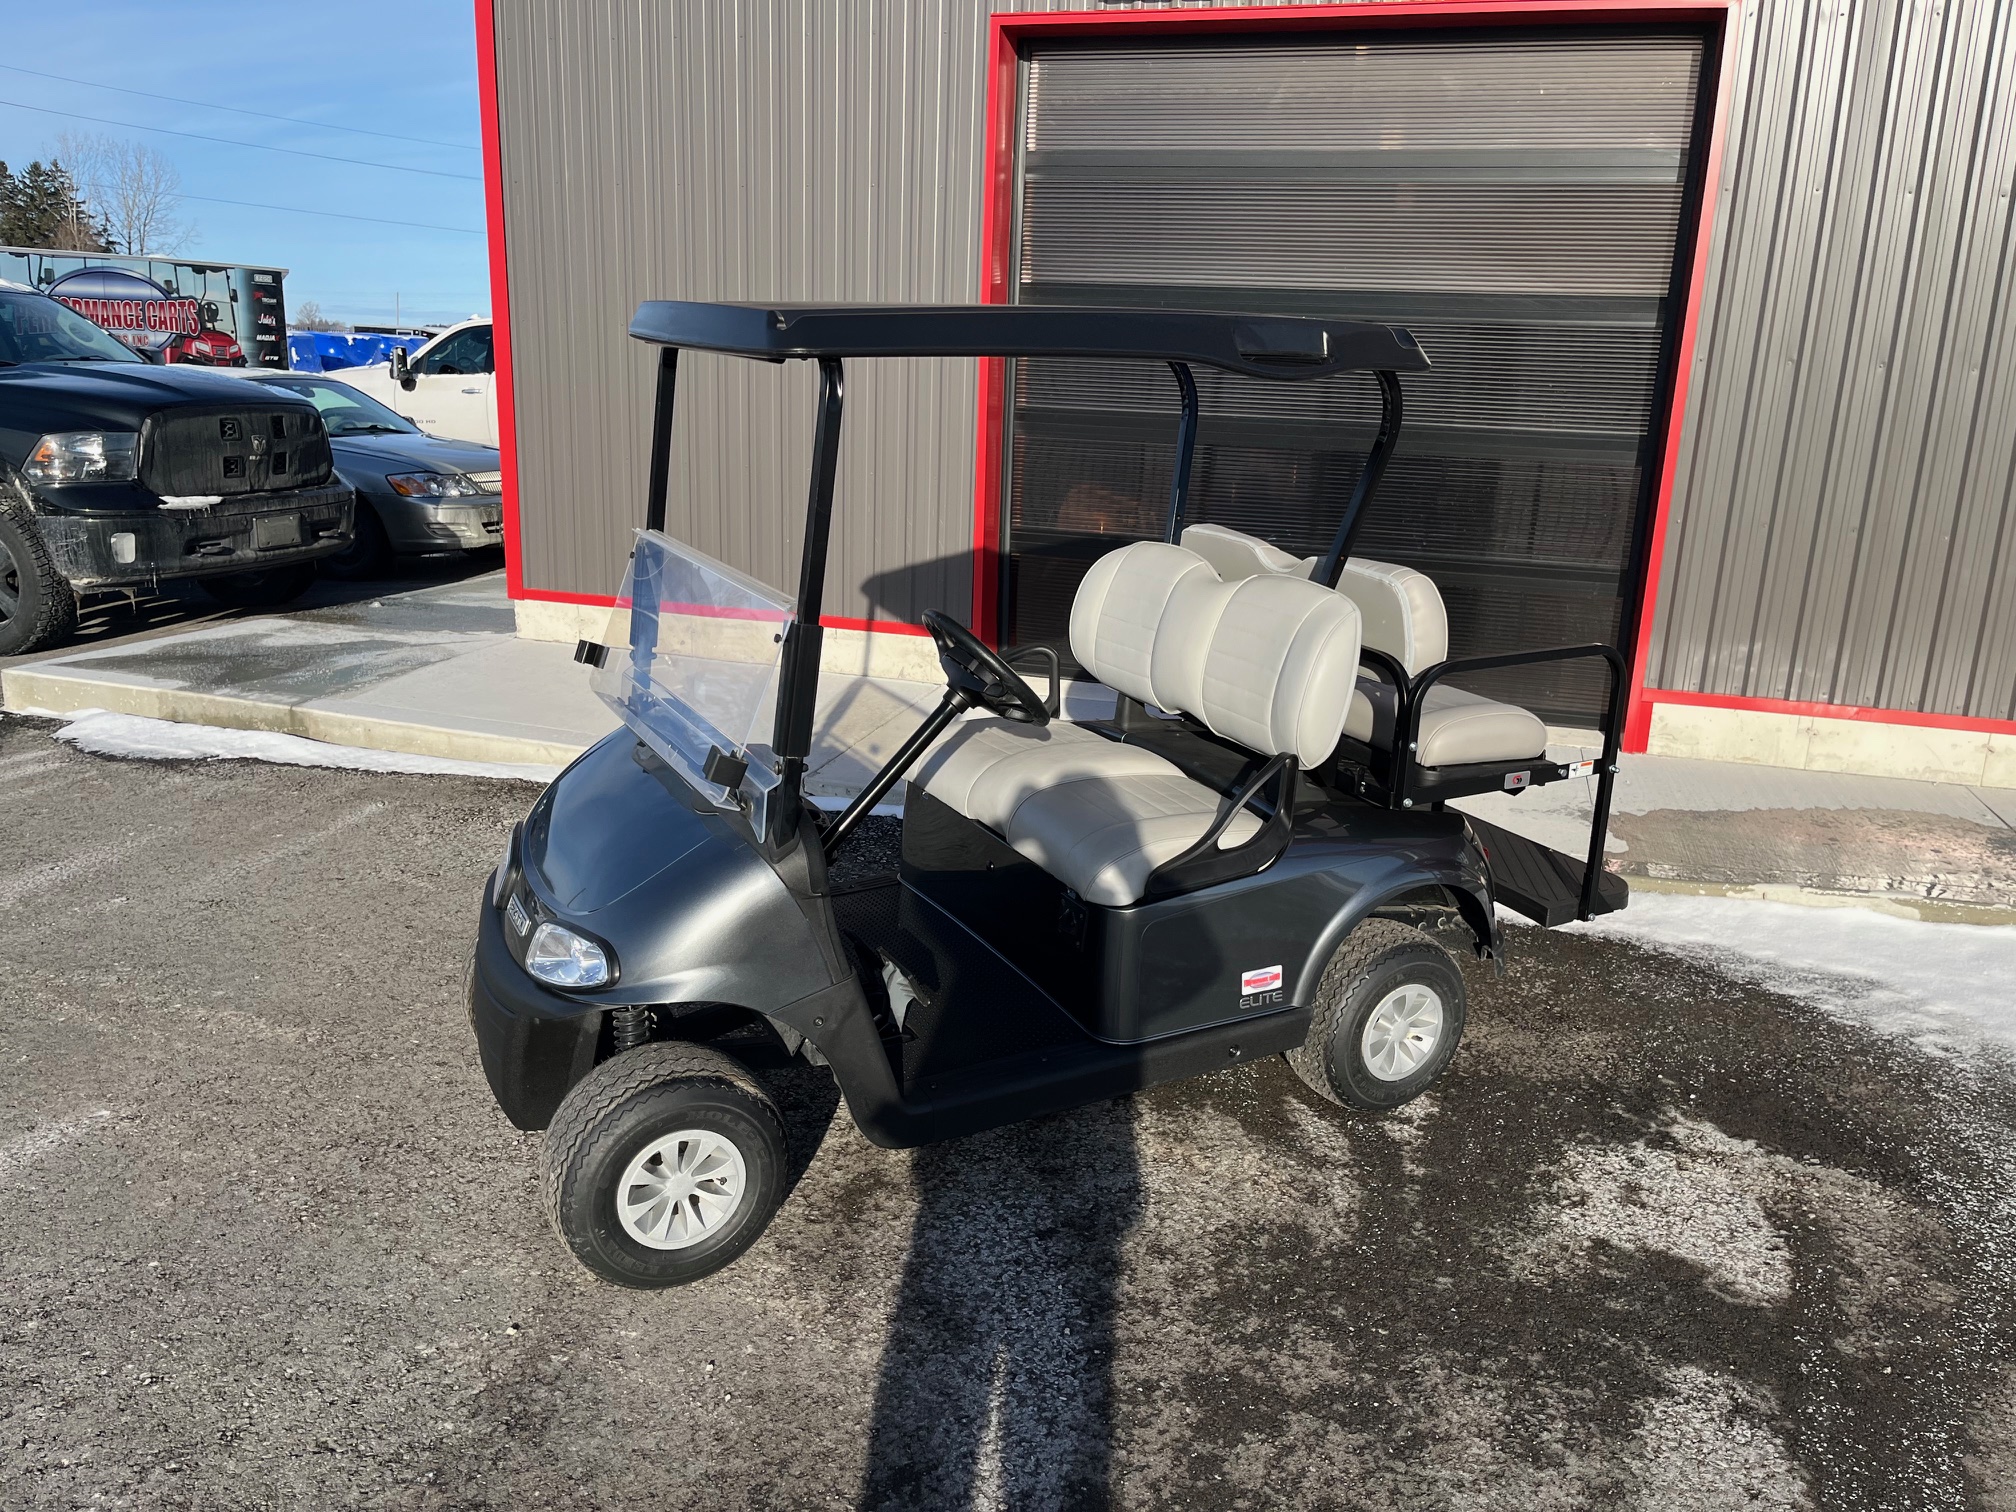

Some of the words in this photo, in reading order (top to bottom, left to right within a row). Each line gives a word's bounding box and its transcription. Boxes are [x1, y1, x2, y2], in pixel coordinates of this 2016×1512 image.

[145, 299, 200, 336] CARTS
[131, 334, 149, 347] INC
[256, 334, 280, 342] MADJAX
[1239, 990, 1283, 1010] ELITE
